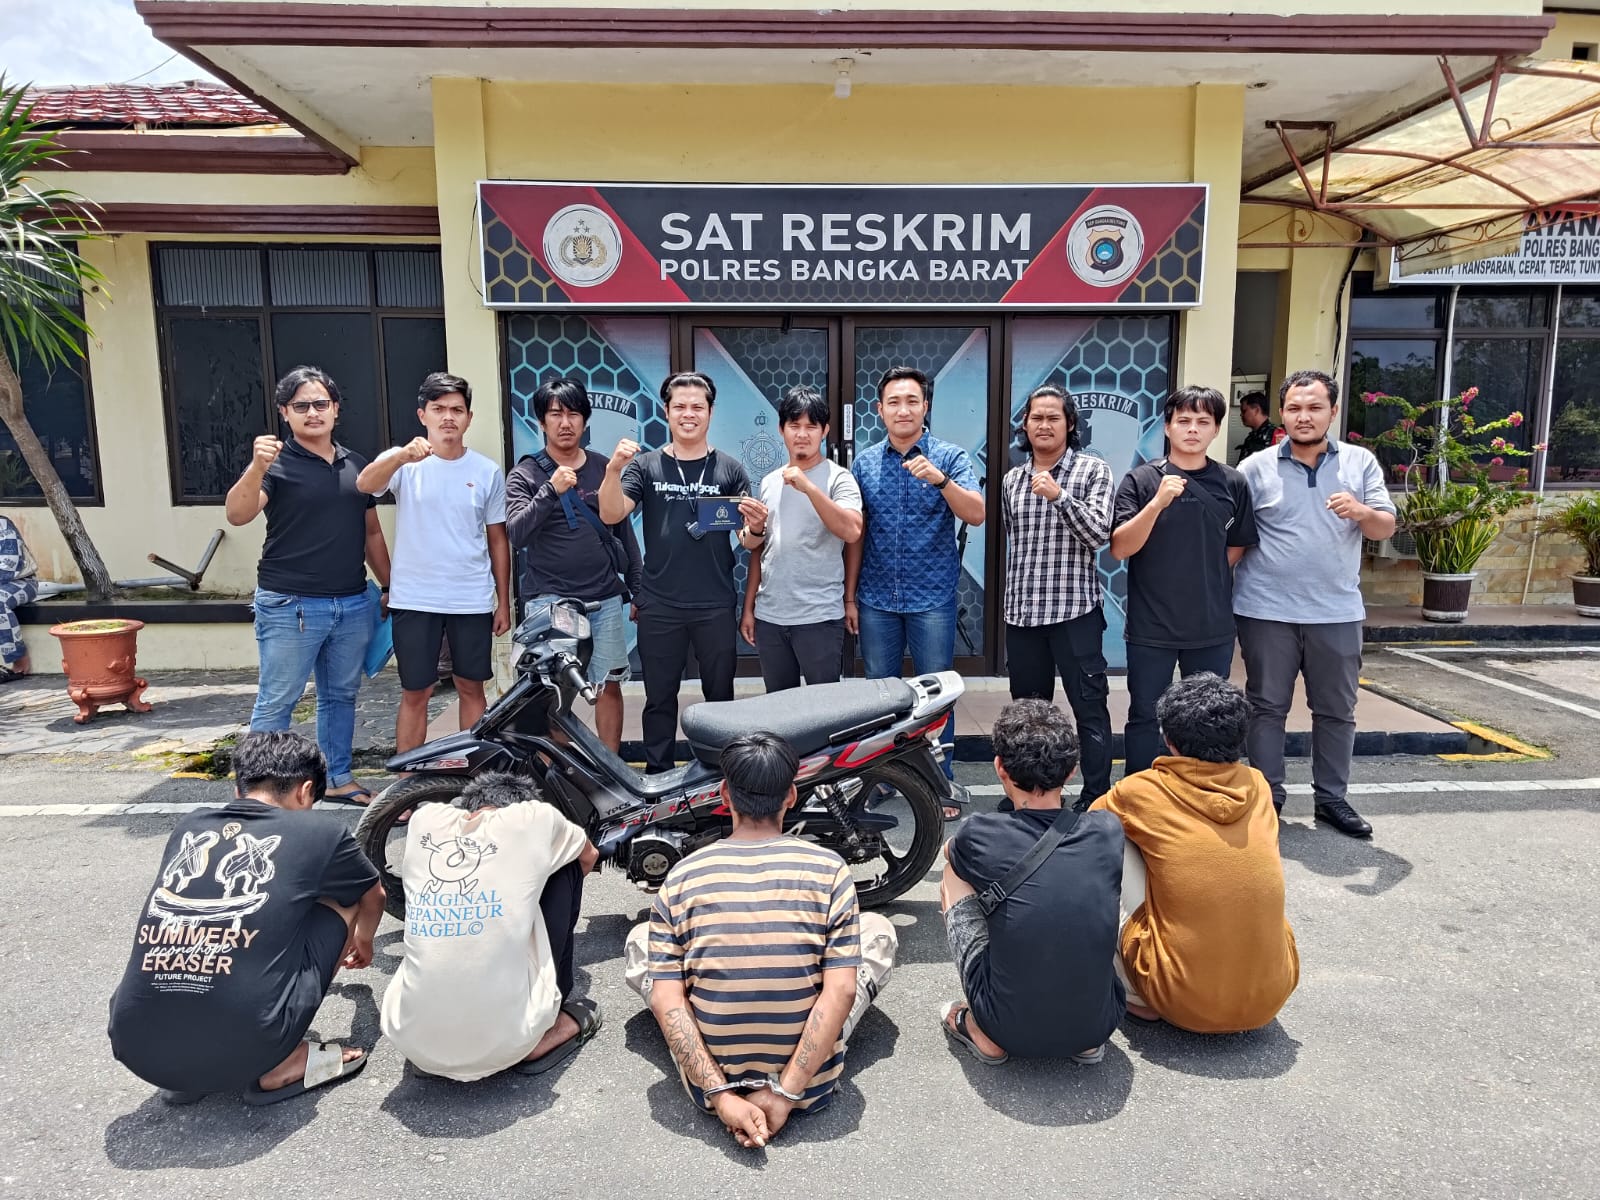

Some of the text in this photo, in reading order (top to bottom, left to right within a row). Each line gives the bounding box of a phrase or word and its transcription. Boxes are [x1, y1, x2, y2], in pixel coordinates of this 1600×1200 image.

[660, 212, 1032, 251] SAT RESKRIM
[1523, 210, 1600, 236] AYAN
[1524, 239, 1567, 257] POLRES
[660, 258, 1030, 282] POLRES BANGKA BARAT
[1458, 260, 1516, 277] TRANSPARAN,
[1518, 260, 1546, 277] CEPAT,
[1550, 260, 1576, 277] TEPAT,
[587, 394, 631, 414] SKRIM
[1072, 394, 1133, 414] RESKRIM
[138, 924, 260, 949] SUMMERY
[141, 952, 233, 975] ERASER
[154, 973, 213, 983] FUTURE PROJECT
